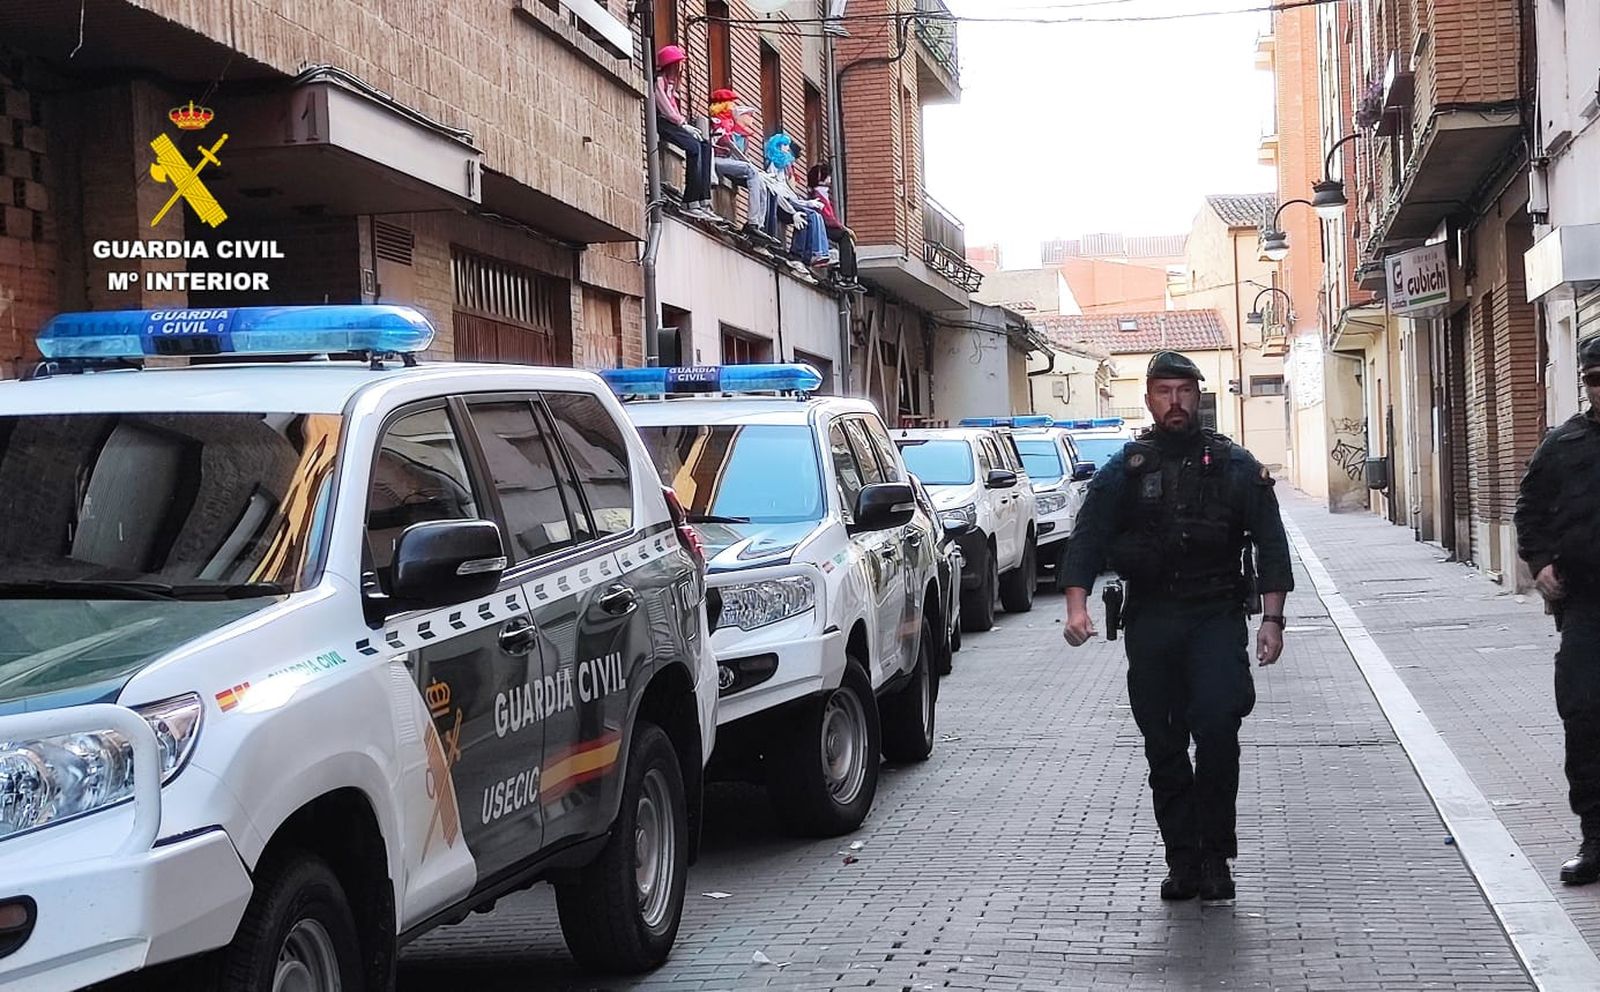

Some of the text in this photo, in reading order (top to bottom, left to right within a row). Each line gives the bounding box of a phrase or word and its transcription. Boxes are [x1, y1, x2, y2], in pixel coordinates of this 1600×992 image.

[150, 310, 228, 321] GUARDIA
[162, 321, 209, 334] CIVIL
[315, 650, 347, 669] CIVIL
[494, 652, 627, 738] GUARDIA CIVIL
[481, 766, 540, 825] USECIC
